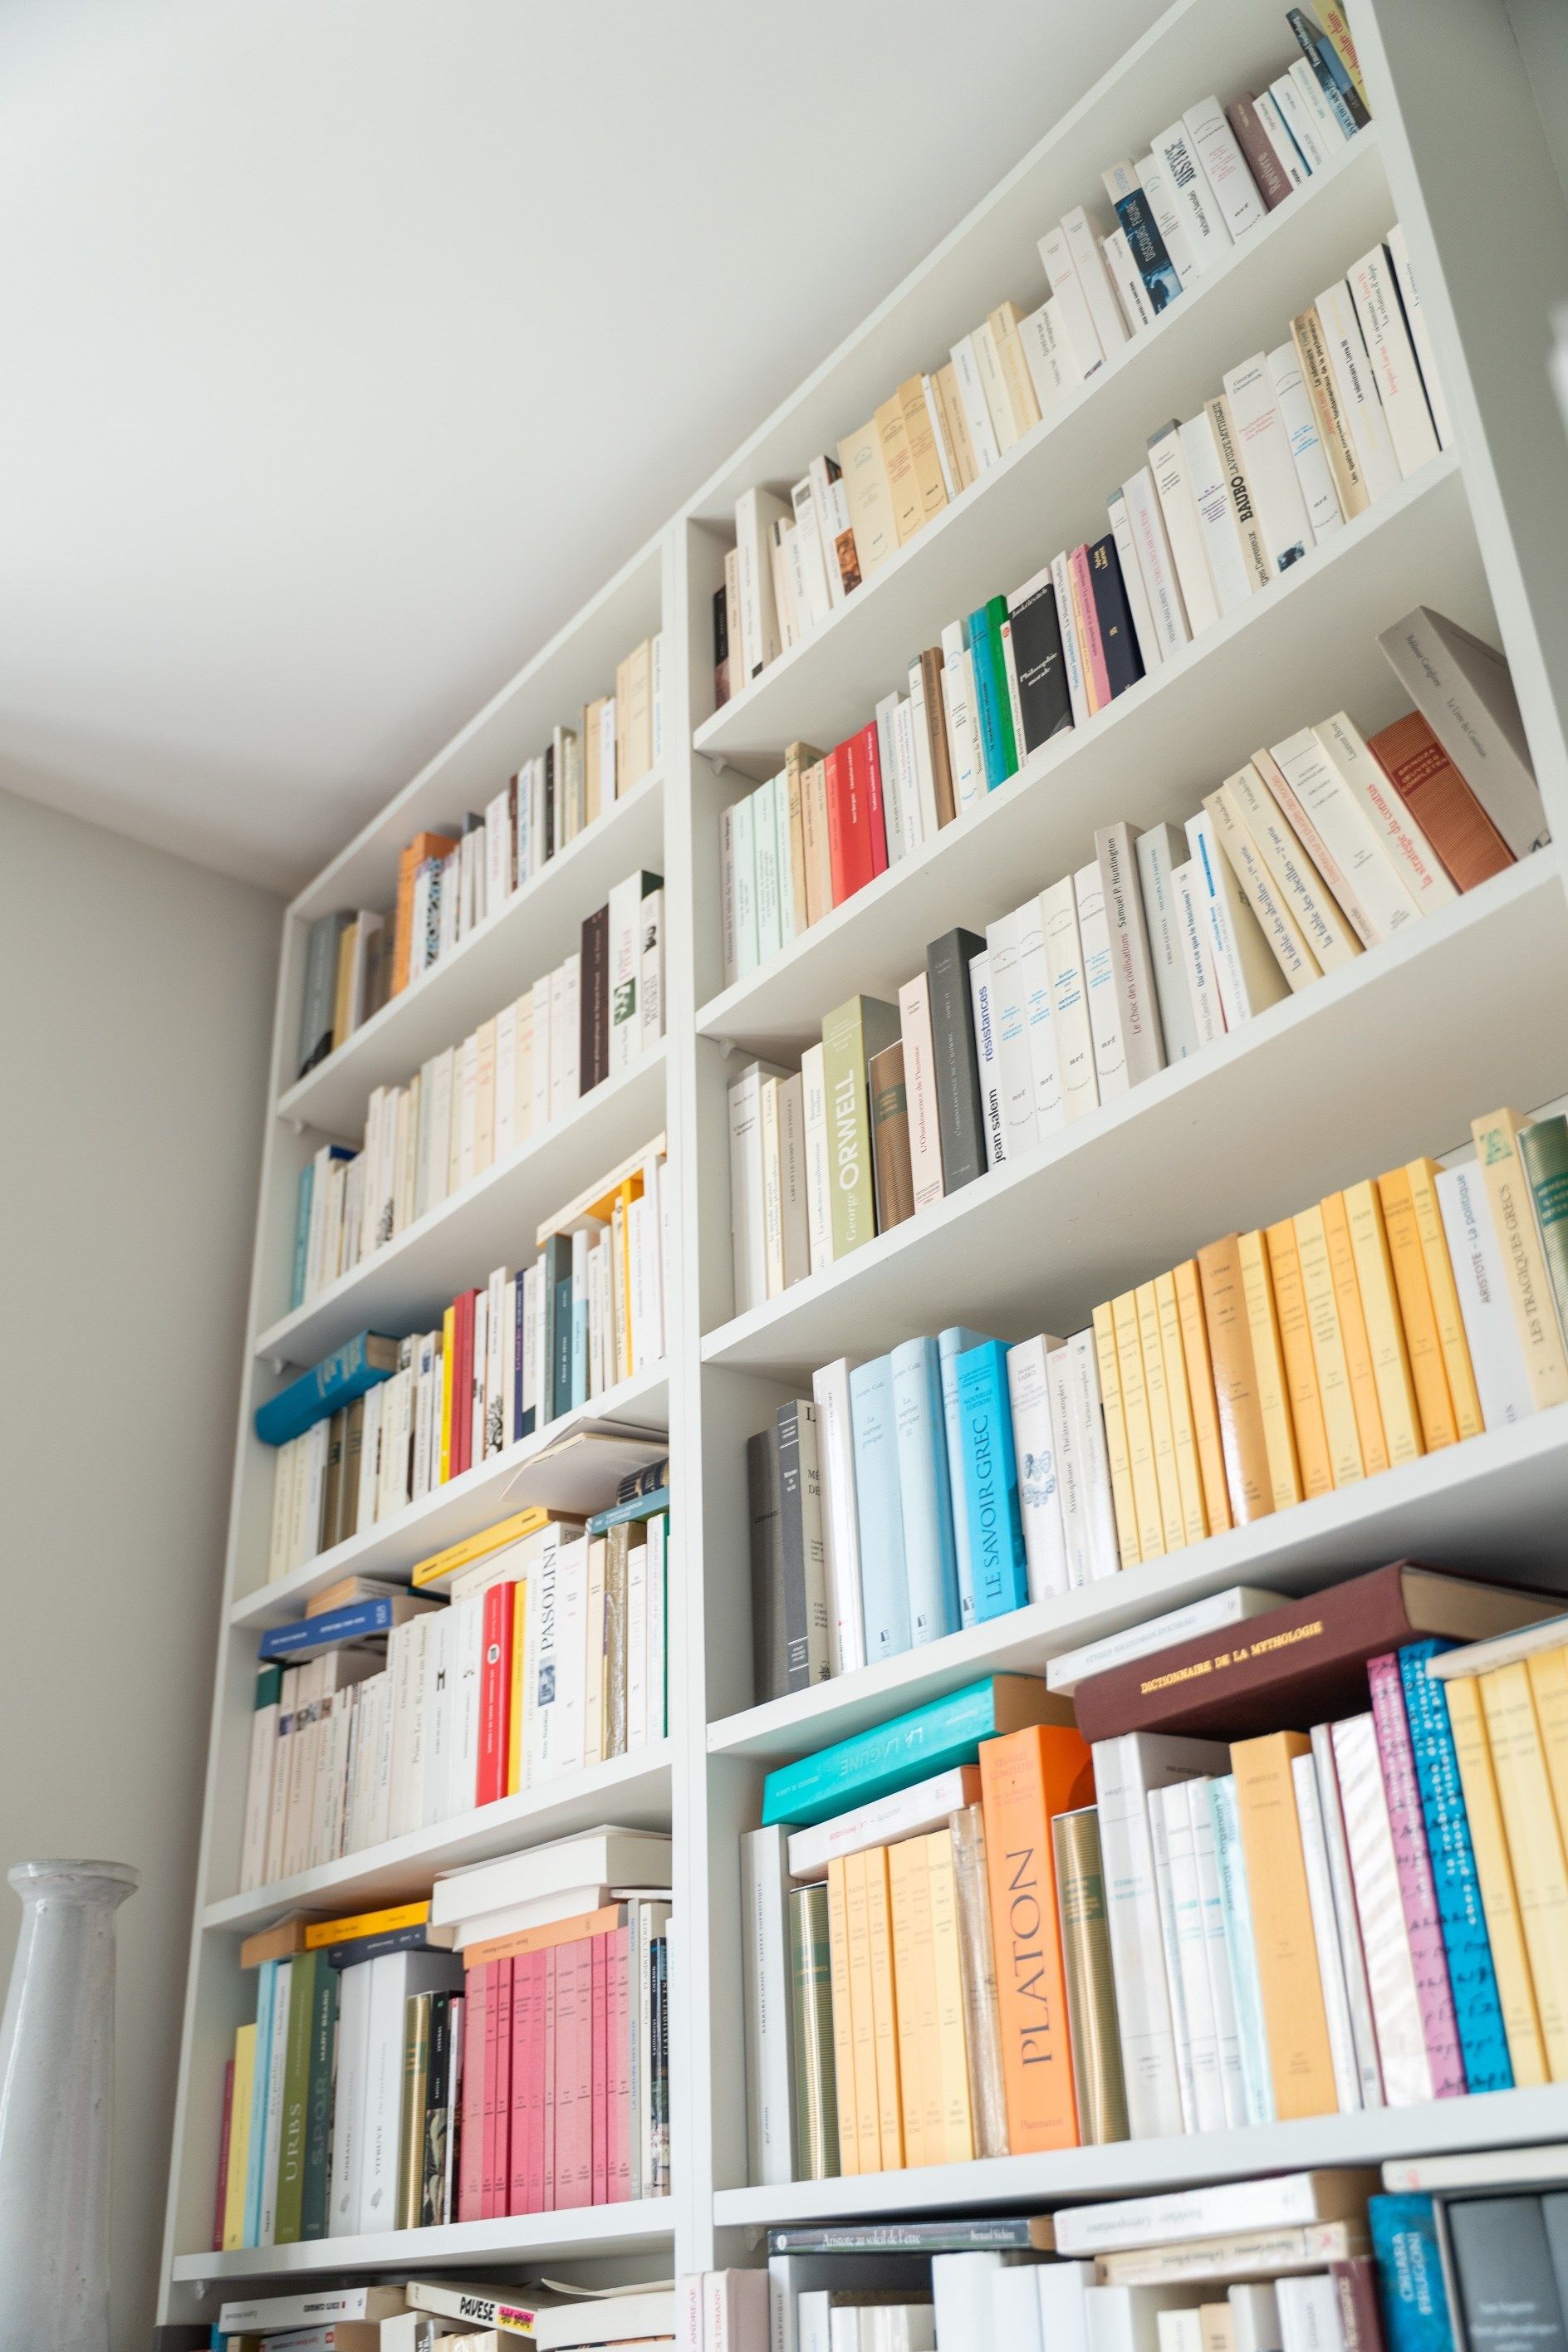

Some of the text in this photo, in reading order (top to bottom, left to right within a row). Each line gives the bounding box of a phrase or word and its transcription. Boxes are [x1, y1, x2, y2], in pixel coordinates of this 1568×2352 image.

[1164, 135, 1197, 191] JUSTICE
[1253, 150, 1281, 196] Revivre
[1122, 198, 1143, 230] FIGURE
[1364, 297, 1381, 336] séminaire
[1372, 286, 1387, 316] relation
[1379, 313, 1389, 327] La
[1306, 313, 1324, 358] psychanalyse
[1374, 331, 1383, 345] Le
[1317, 355, 1325, 365] la
[1320, 364, 1329, 377] de
[1339, 337, 1364, 404] Le séminaire Livre III
[1323, 375, 1340, 422] fondamentaux
[1212, 398, 1238, 477] LA VULVE MYTHIQUE
[1344, 447, 1356, 472] quatre
[1350, 470, 1359, 486] Les
[1228, 472, 1253, 526] BAUBO
[1445, 698, 1457, 709] Le
[1450, 706, 1466, 724] Livre
[1327, 719, 1357, 762] Laurent Bove
[1460, 721, 1472, 733] du
[1398, 748, 1435, 776] SPINOZA
[1236, 774, 1257, 806] Mandeville
[1282, 796, 1296, 809] des
[1213, 794, 1232, 825] Mandeville
[1264, 825, 1281, 845] partie
[1305, 832, 1316, 844] la
[1311, 840, 1322, 852] sur
[1363, 781, 1434, 889] la stratégie du conatus
[1237, 844, 1254, 865] partie
[1106, 834, 1126, 930] Samuel P. Huntington
[1281, 859, 1312, 905] abeilles
[1254, 880, 1281, 928] abeilles
[1300, 893, 1316, 913] des
[1187, 929, 1194, 938] le
[1271, 914, 1286, 935] des
[1308, 910, 1328, 937] fable
[1321, 934, 1334, 947] la
[1189, 936, 1198, 953] que
[1278, 932, 1298, 960] fable
[1290, 957, 1302, 970] la
[1119, 931, 1139, 1037] Le Choc des civilisations
[1191, 951, 1204, 989] Qu'est-ce
[976, 983, 993, 1065] résistances
[1198, 991, 1214, 1041] Emilio Gentile
[1067, 1051, 1085, 1066] nrf
[1100, 1034, 1117, 1049] nrf
[946, 1031, 962, 1138] L'OBSOLESCENCE DE L'HOMME
[1012, 1087, 1027, 1101] nrf
[1038, 1072, 1055, 1086] nrf
[912, 1044, 928, 1155] L'Obsolescence de l'homme
[833, 1067, 860, 1195] ORWELL
[986, 1086, 1006, 1167] jean salem
[814, 1140, 822, 1187] malheureuse
[817, 1224, 824, 1236] La
[845, 1188, 857, 1243] George
[1453, 1173, 1492, 1306] ARISTOTE La politique
[1497, 1183, 1544, 1345] LES TRAGIQUES GRECS
[1063, 1459, 1079, 1515] Aristophane
[972, 1413, 1002, 1600] LE SAVOIR GREC
[541, 1537, 556, 1651] PASOLINI
[1139, 1619, 1323, 1695] DICTIONNAIRE DE LA MYTHOLOGIE
[411, 1733, 420, 1765] Primo
[419, 1621, 429, 1659] homme
[902, 1723, 924, 1752] LA
[1414, 1661, 1455, 1875] la recherche du principe
[1213, 1803, 1230, 1855] Organon
[1004, 1845, 1055, 2066] PLATON
[319, 1987, 331, 2061] MARY BEARD
[631, 2099, 637, 2110] LA
[284, 2100, 304, 2182] URBS
[822, 2232, 853, 2247] Aristote
[855, 2236, 864, 2245] au
[865, 2229, 887, 2246] soleil
[887, 2229, 897, 2244] de
[1392, 2232, 1414, 2301] CHIARA
[1406, 2232, 1433, 2315] FRUGONI
[458, 2295, 497, 2323] PAVESE
